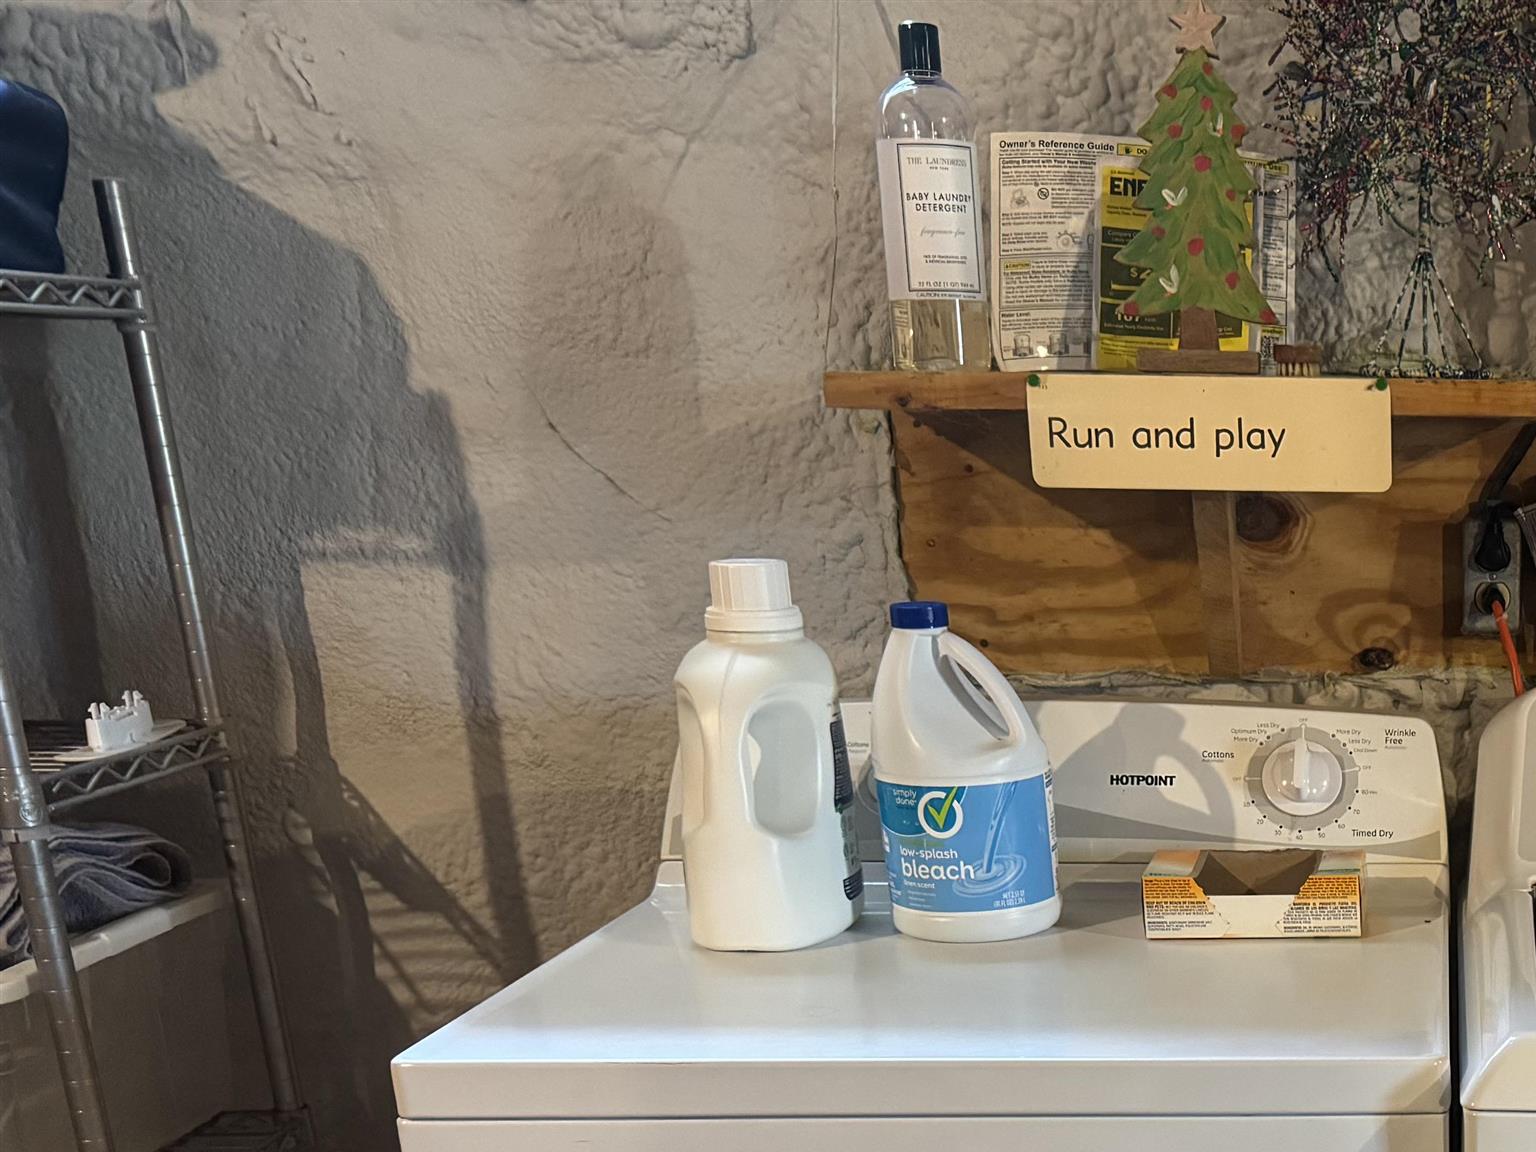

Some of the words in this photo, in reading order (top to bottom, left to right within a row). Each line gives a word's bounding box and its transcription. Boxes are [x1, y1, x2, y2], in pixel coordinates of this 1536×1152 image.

[999, 140, 1036, 149] Owner's
[1038, 140, 1085, 150] Reference
[1087, 143, 1115, 152] Guide
[906, 157, 922, 165] THE
[906, 192, 929, 201] BABY
[932, 192, 971, 203] LAUNDRY
[915, 203, 967, 213] DETERGENT
[1048, 416, 1114, 449] Run
[1132, 416, 1196, 449] and
[1214, 416, 1286, 458] play
[1384, 728, 1417, 737] Wrinkle
[1384, 737, 1403, 745] Free
[1201, 750, 1235, 759] Cottons
[1109, 774, 1177, 787] HOTPOINT
[893, 788, 917, 799] simply
[895, 797, 914, 806] done
[1351, 828, 1377, 838] Timed
[1378, 828, 1394, 839] Dry
[900, 845, 959, 861] low-splash
[901, 858, 975, 881] bleach
